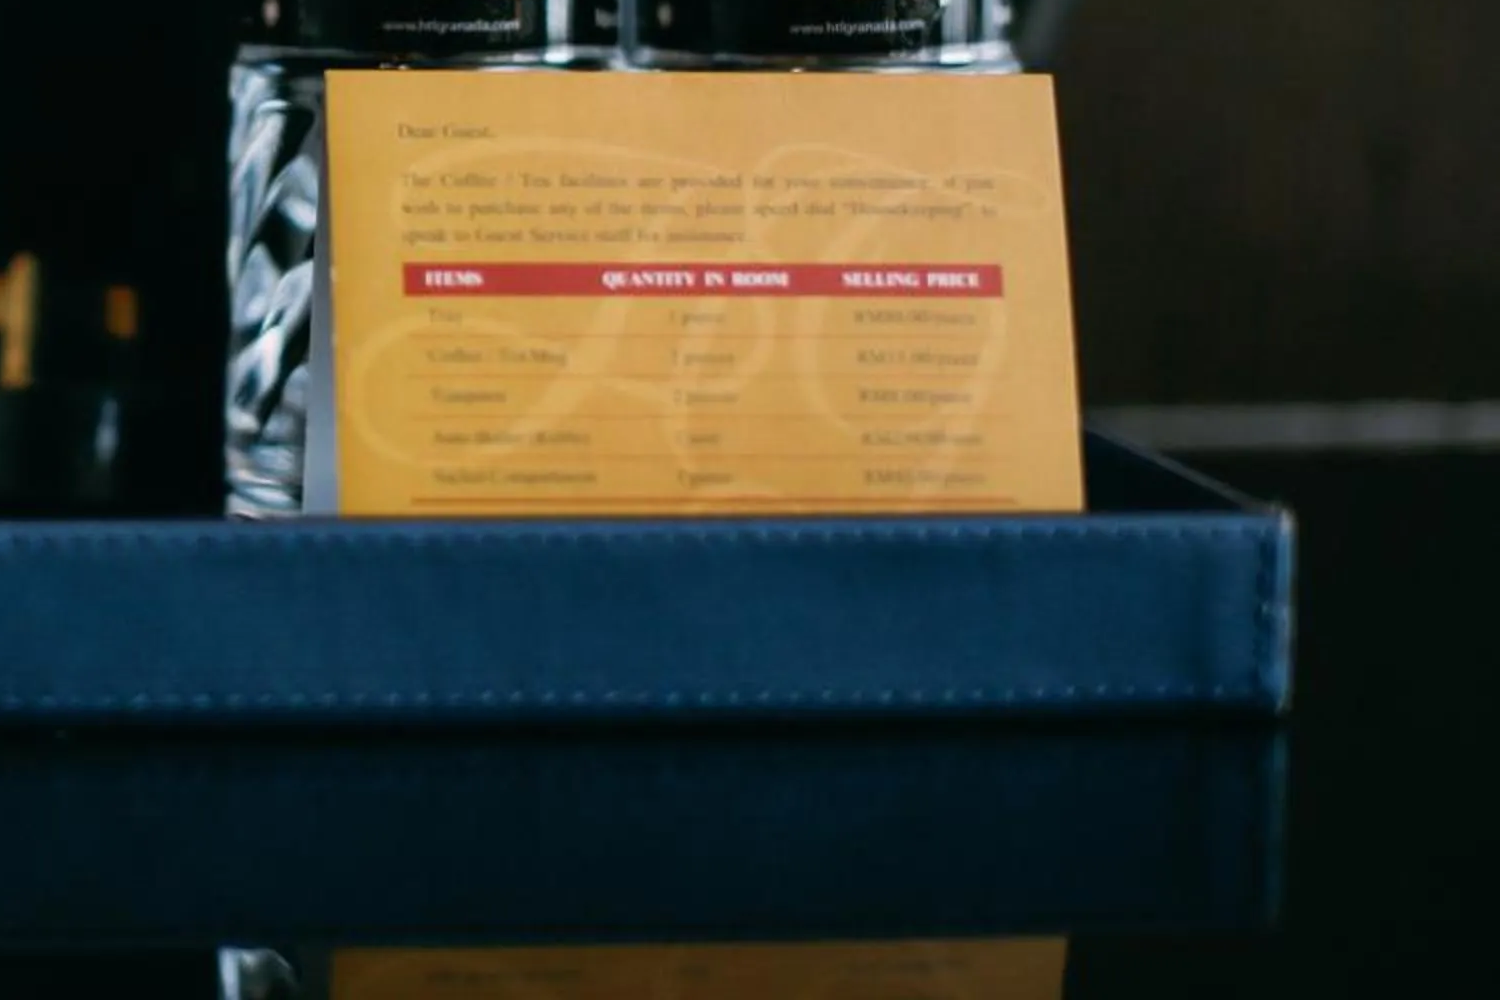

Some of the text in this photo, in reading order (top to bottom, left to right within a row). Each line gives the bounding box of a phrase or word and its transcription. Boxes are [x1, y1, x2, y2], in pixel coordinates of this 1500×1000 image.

[424, 269, 979, 290] ITEMS QUANTITY IN ROOM SELLING PRICE
